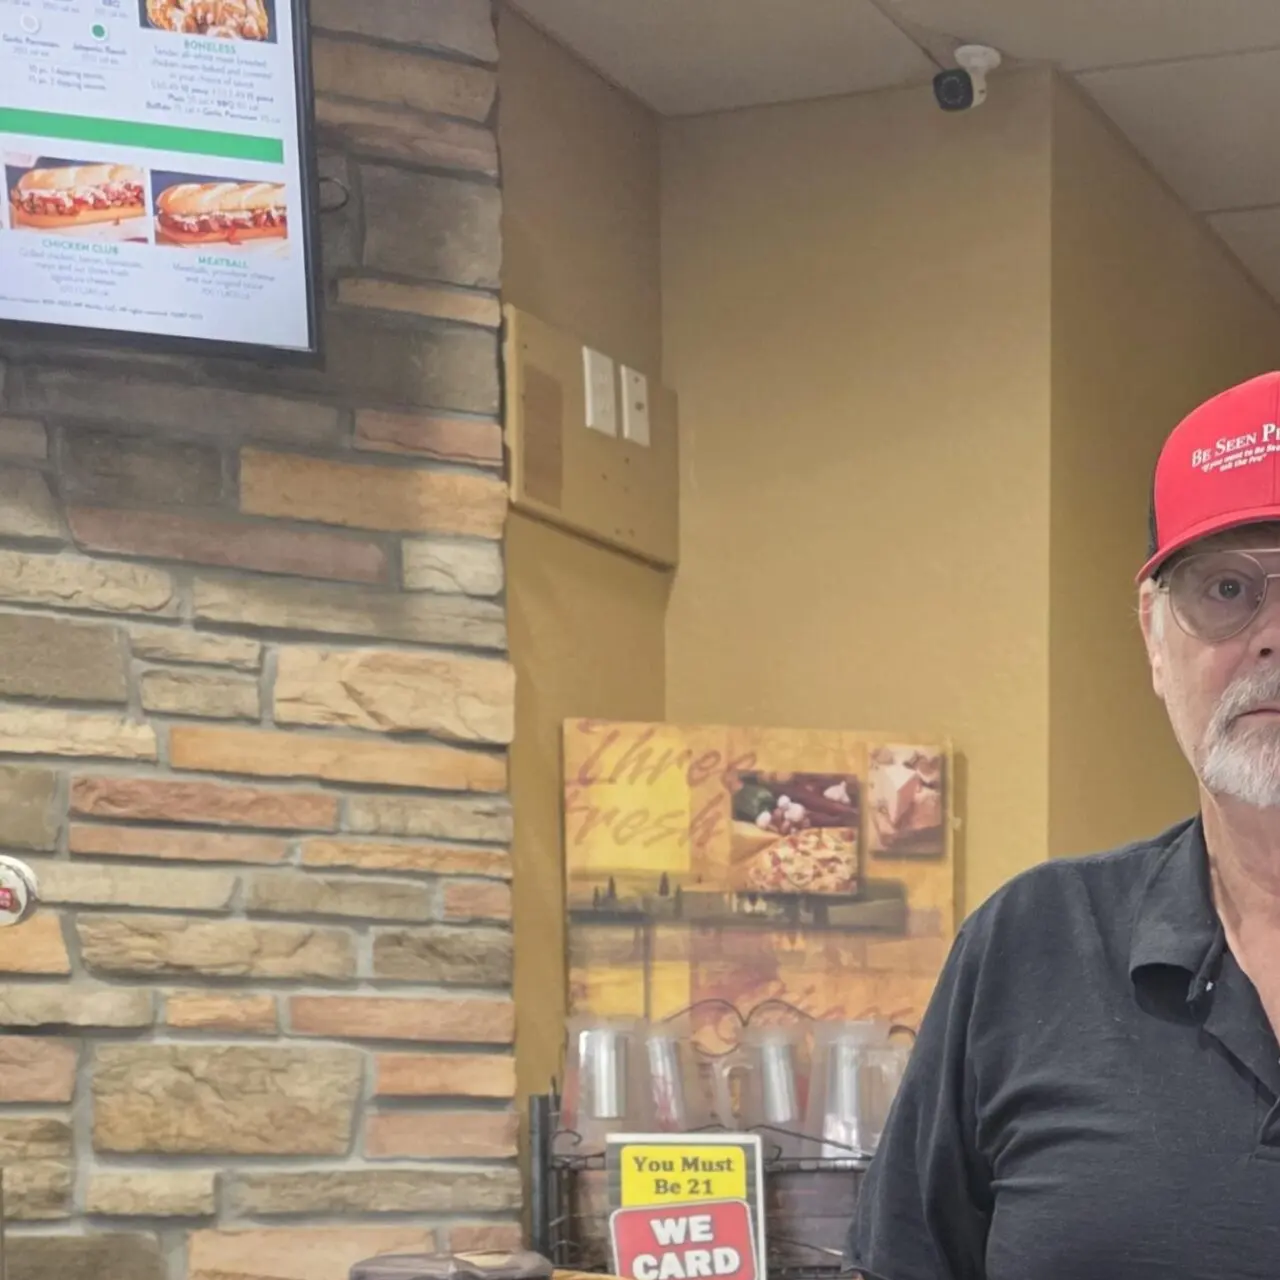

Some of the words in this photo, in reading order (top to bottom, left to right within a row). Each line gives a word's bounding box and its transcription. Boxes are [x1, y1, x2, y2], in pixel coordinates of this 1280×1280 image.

[184, 39, 237, 55] BONELESS
[42, 239, 90, 252] CHICKEN
[92, 244, 119, 256] CLUB
[198, 256, 248, 269] MEATBALL
[633, 1156, 675, 1172] You
[680, 1156, 736, 1172] Must
[654, 1178, 682, 1195] Be
[687, 1178, 714, 1195] 21
[650, 1214, 714, 1246] WE
